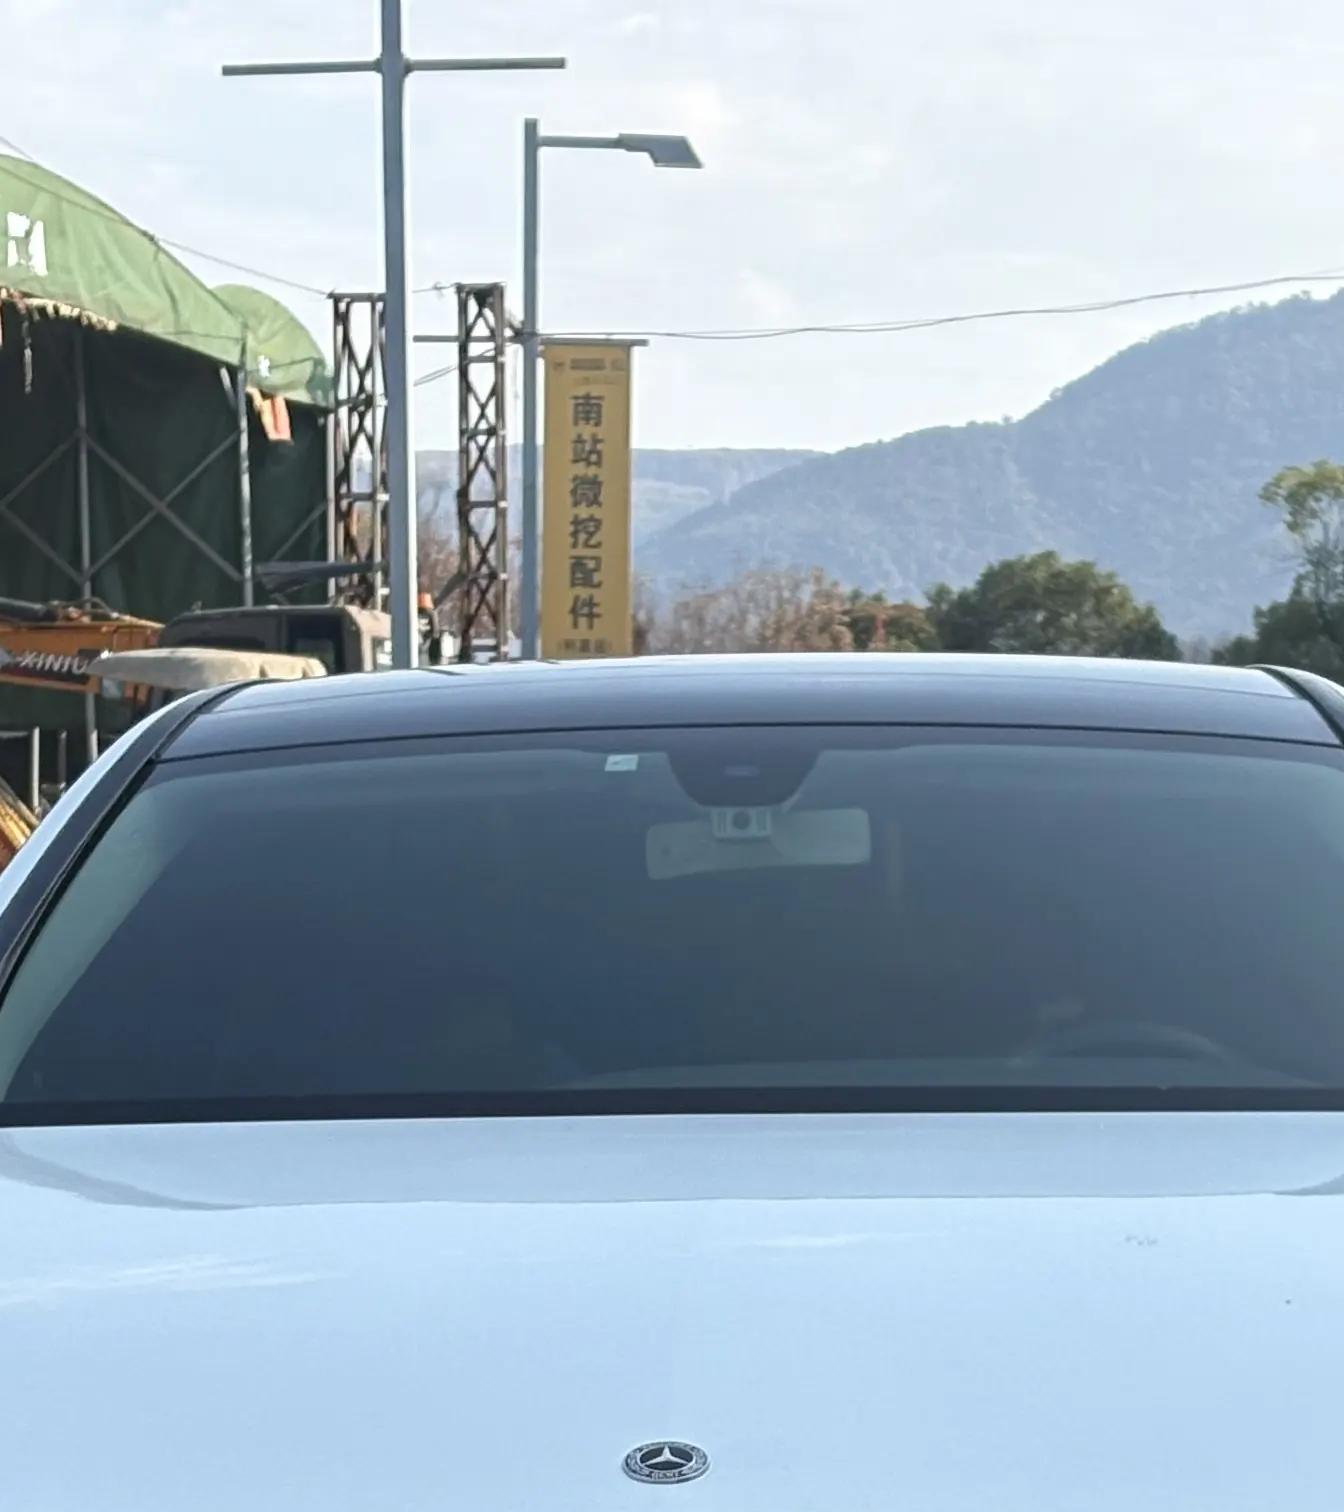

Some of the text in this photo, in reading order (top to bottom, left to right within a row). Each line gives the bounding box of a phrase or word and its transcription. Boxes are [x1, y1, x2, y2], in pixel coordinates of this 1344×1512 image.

[569, 393, 604, 630] 南站微挖配件
